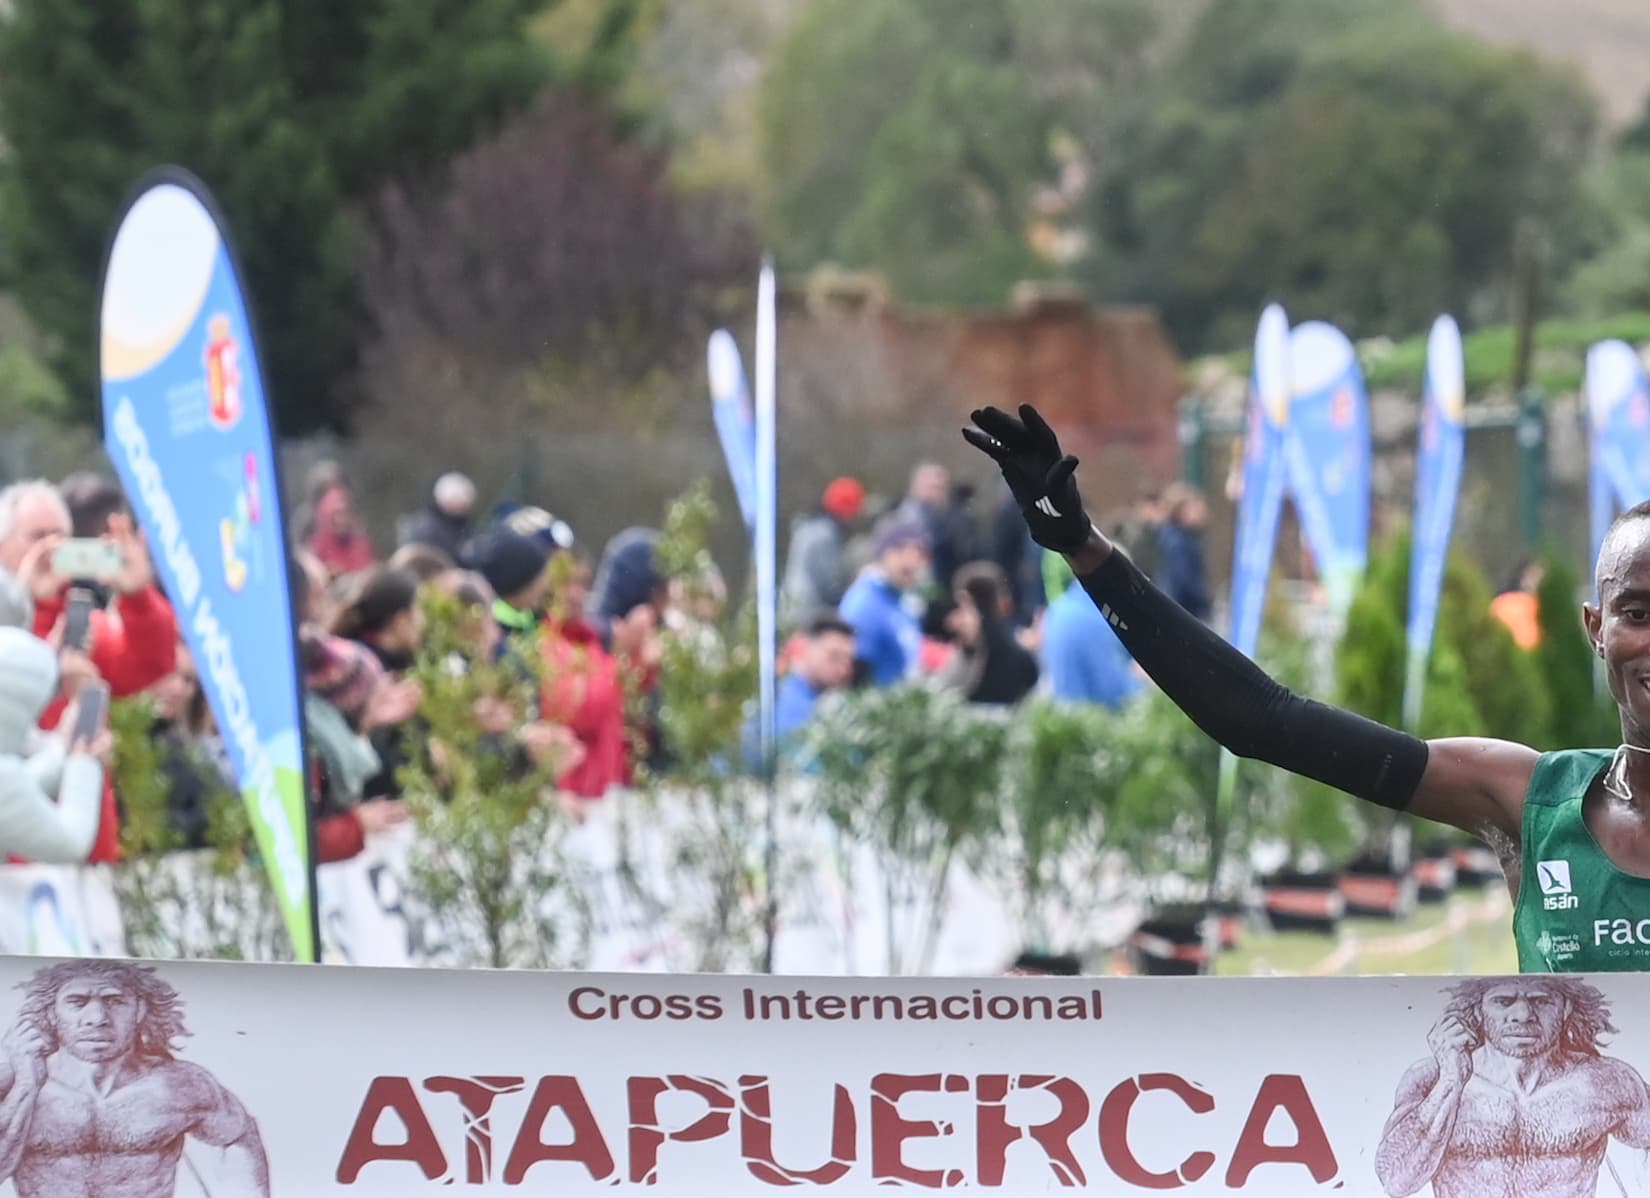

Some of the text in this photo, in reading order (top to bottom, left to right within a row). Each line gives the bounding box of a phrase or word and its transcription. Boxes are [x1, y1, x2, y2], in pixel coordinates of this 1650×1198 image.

[568, 987, 1103, 1021] Cross Internacional
[336, 1072, 1343, 1190] ATAPUERCA
